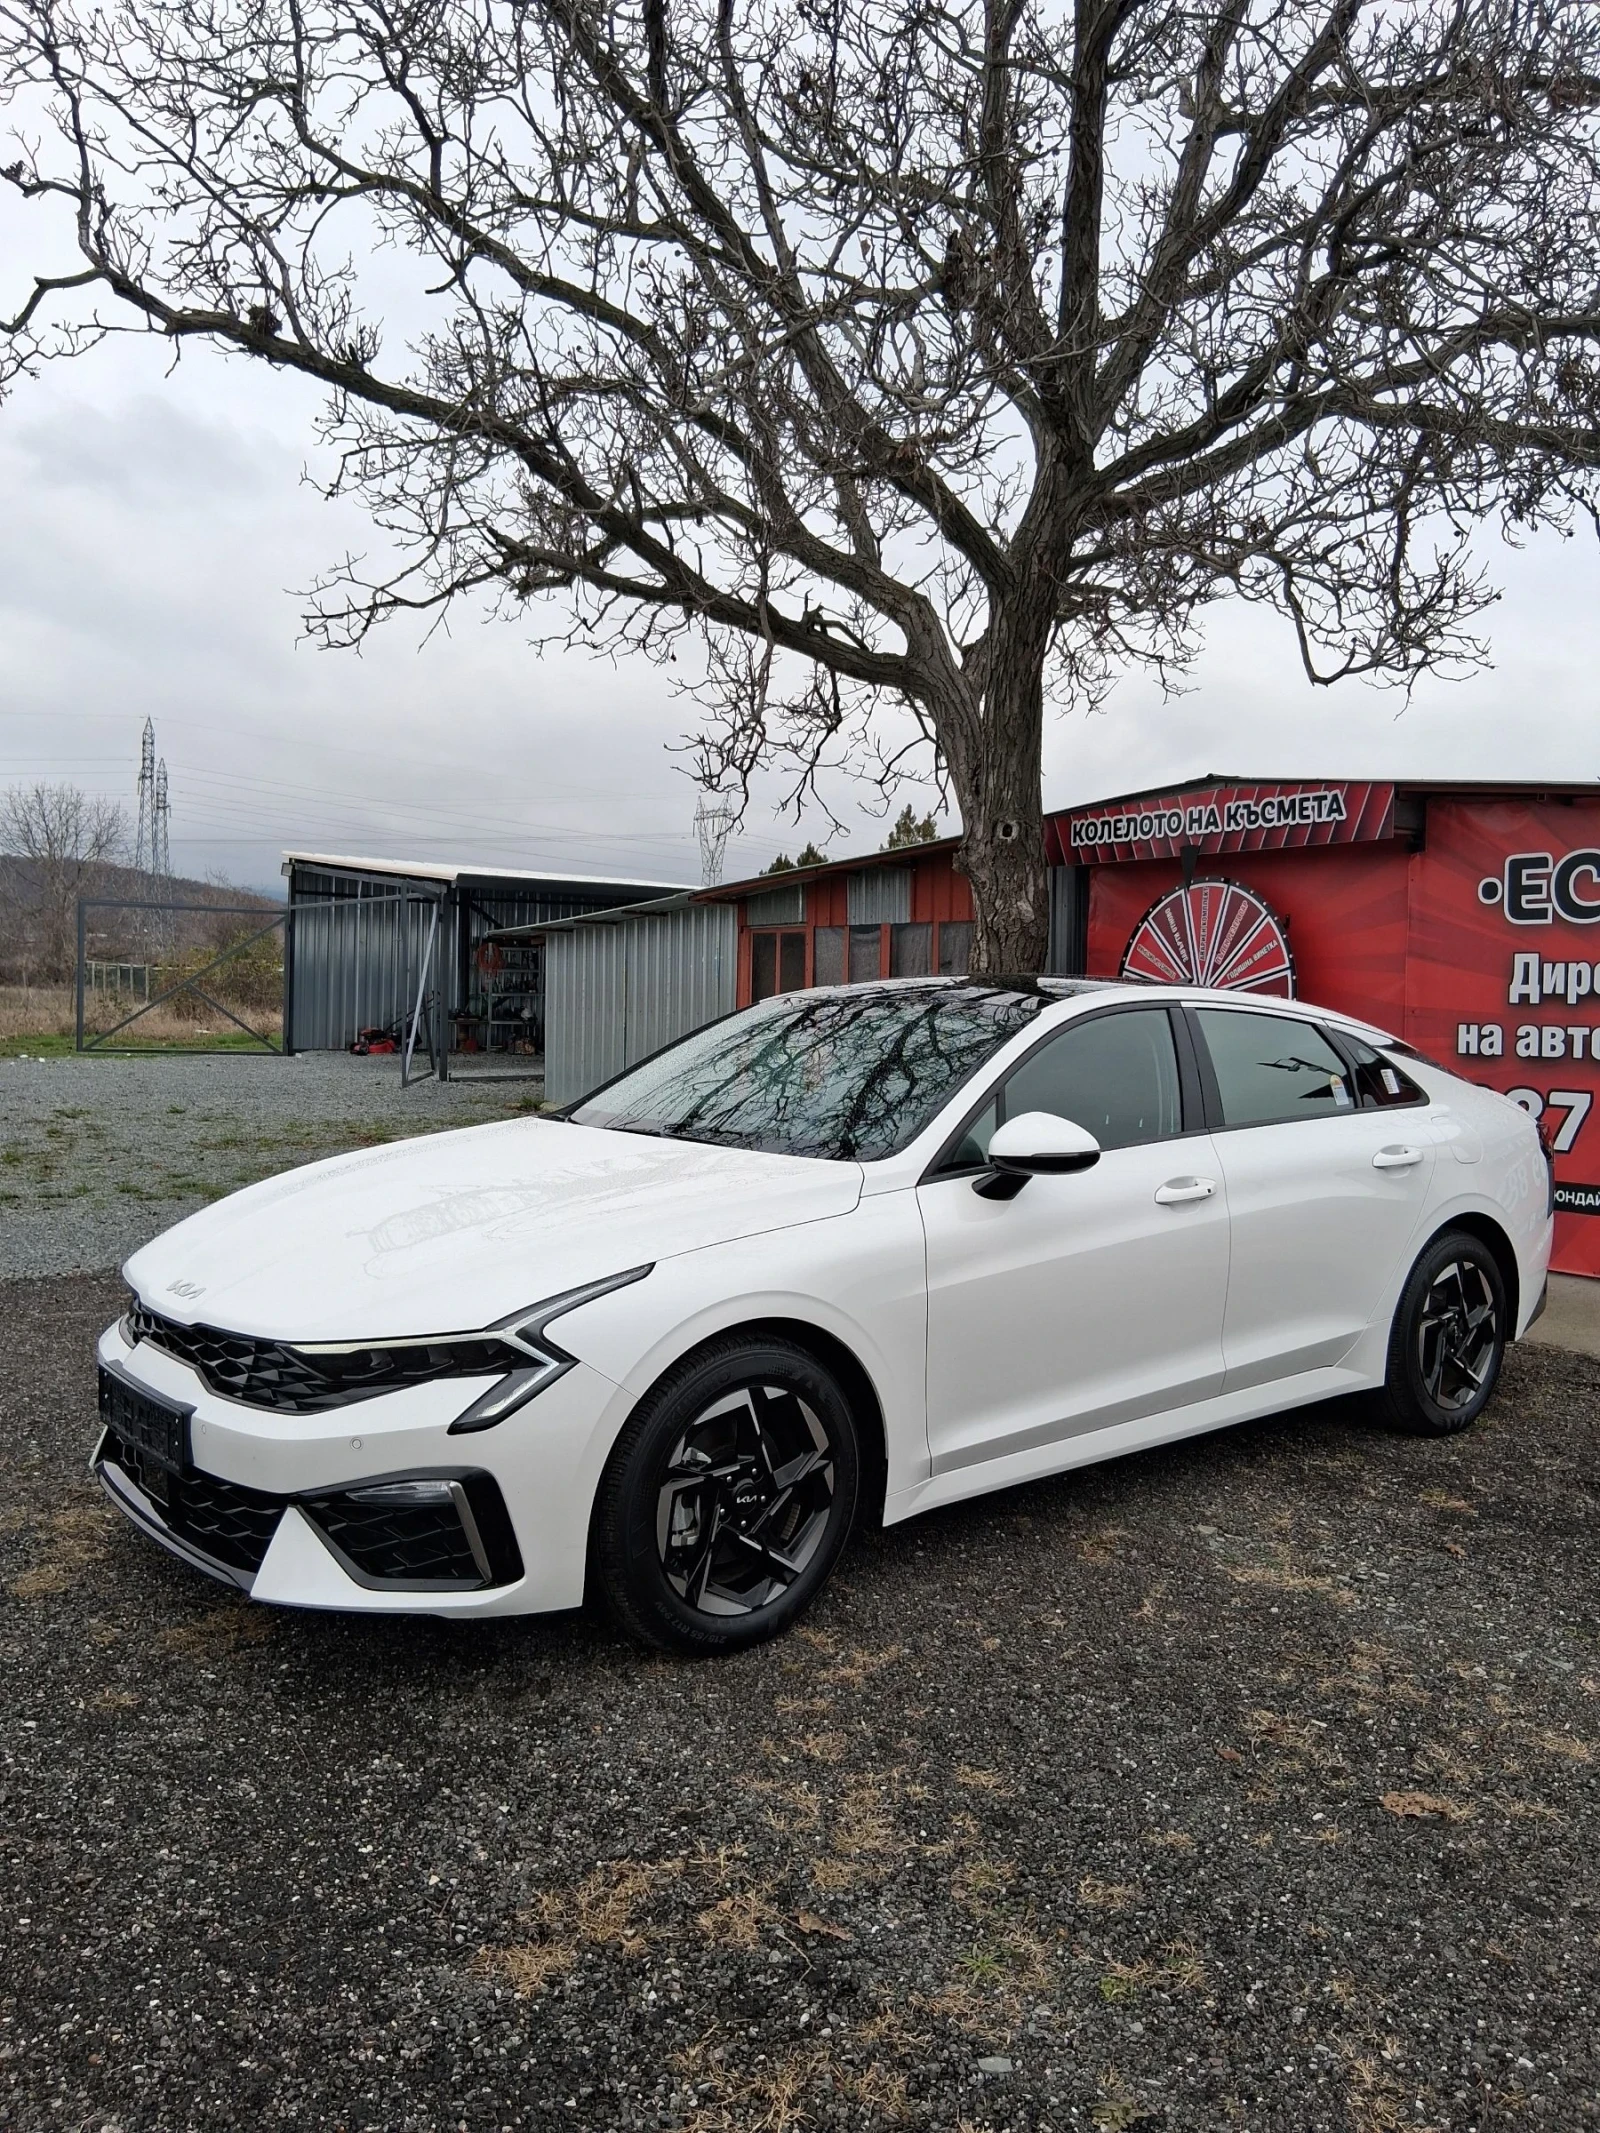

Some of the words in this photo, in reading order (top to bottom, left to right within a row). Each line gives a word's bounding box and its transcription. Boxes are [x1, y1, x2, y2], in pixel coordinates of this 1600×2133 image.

[1071, 812, 1184, 846] КОЛЕЛОТО
[1187, 804, 1221, 834] НА
[1225, 790, 1347, 831] КЪСМЕТА
[1457, 1023, 1503, 1056] на
[166, 1279, 206, 1300] KIA
[736, 1494, 758, 1504] KIA
